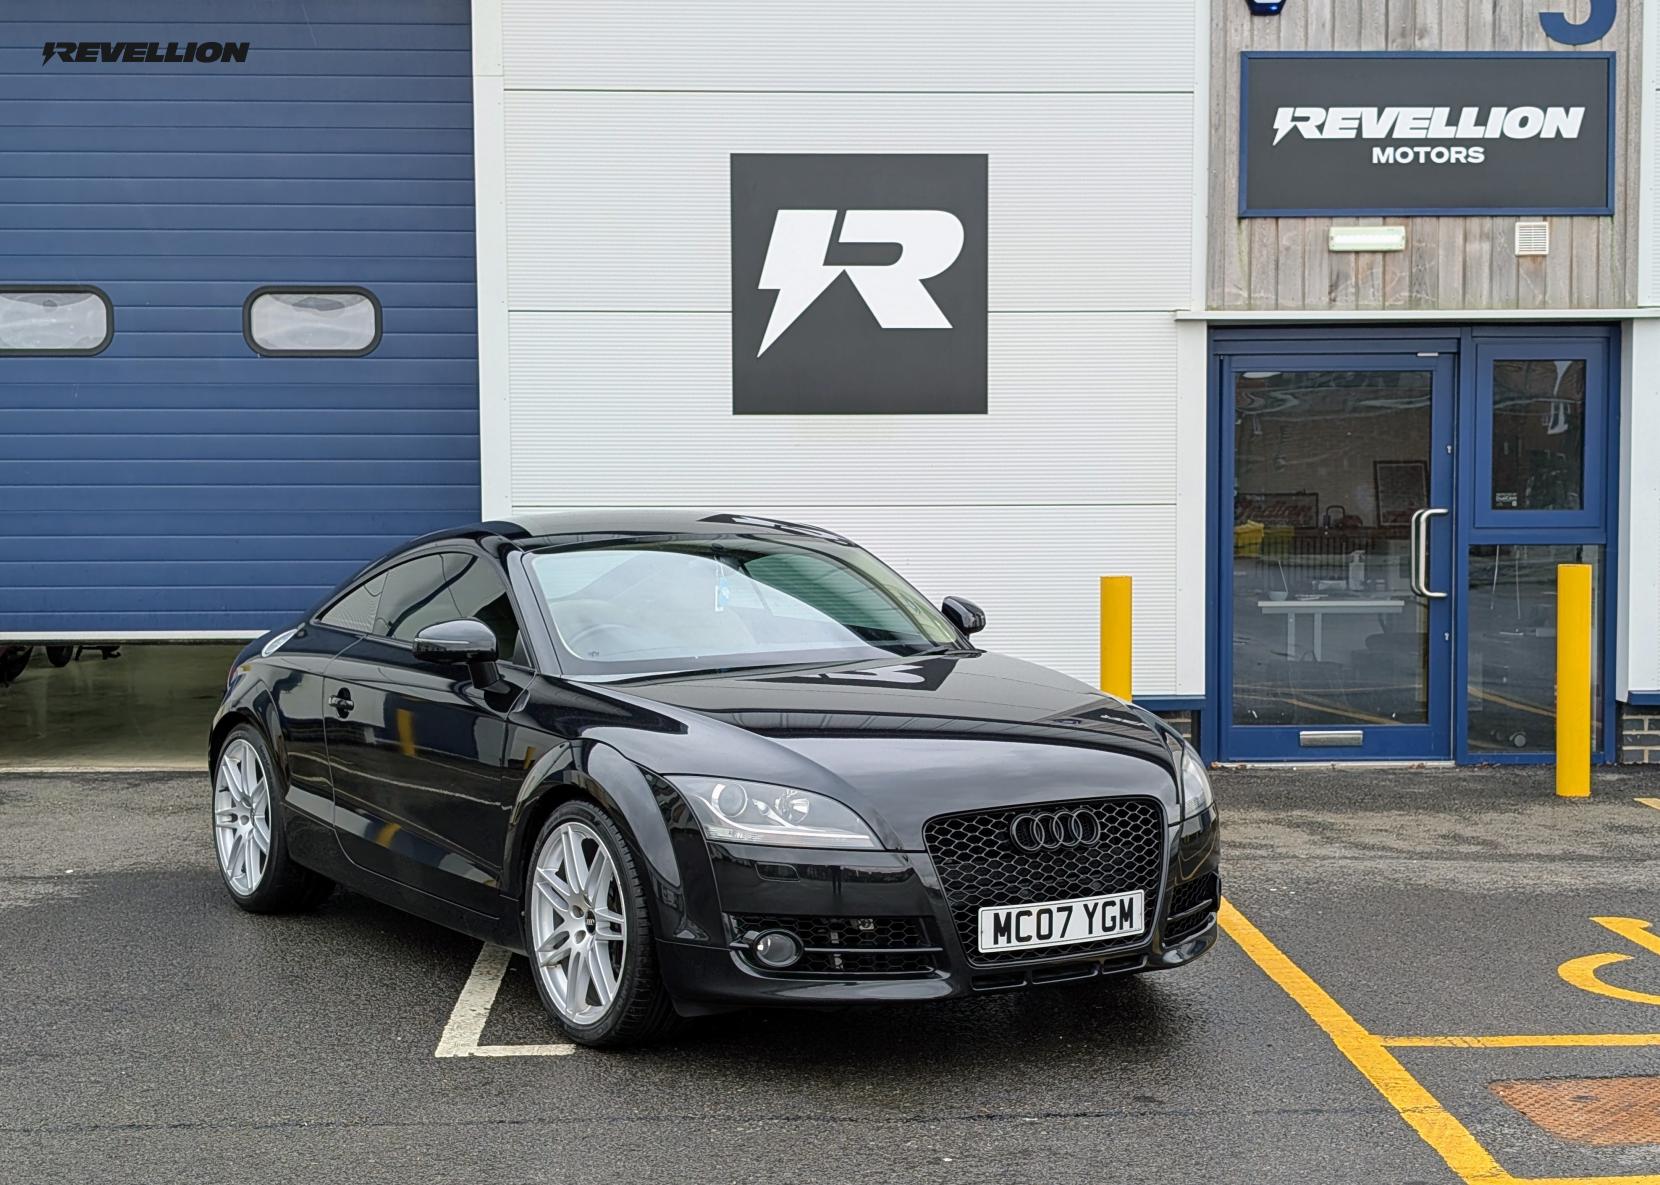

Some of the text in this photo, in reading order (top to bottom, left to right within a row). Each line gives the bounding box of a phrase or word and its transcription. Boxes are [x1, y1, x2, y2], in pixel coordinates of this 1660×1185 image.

[1272, 106, 1586, 146] REVELLION
[1371, 146, 1486, 164] MOTORS
[756, 208, 965, 358] R
[993, 897, 1134, 945] MC07 YGM
